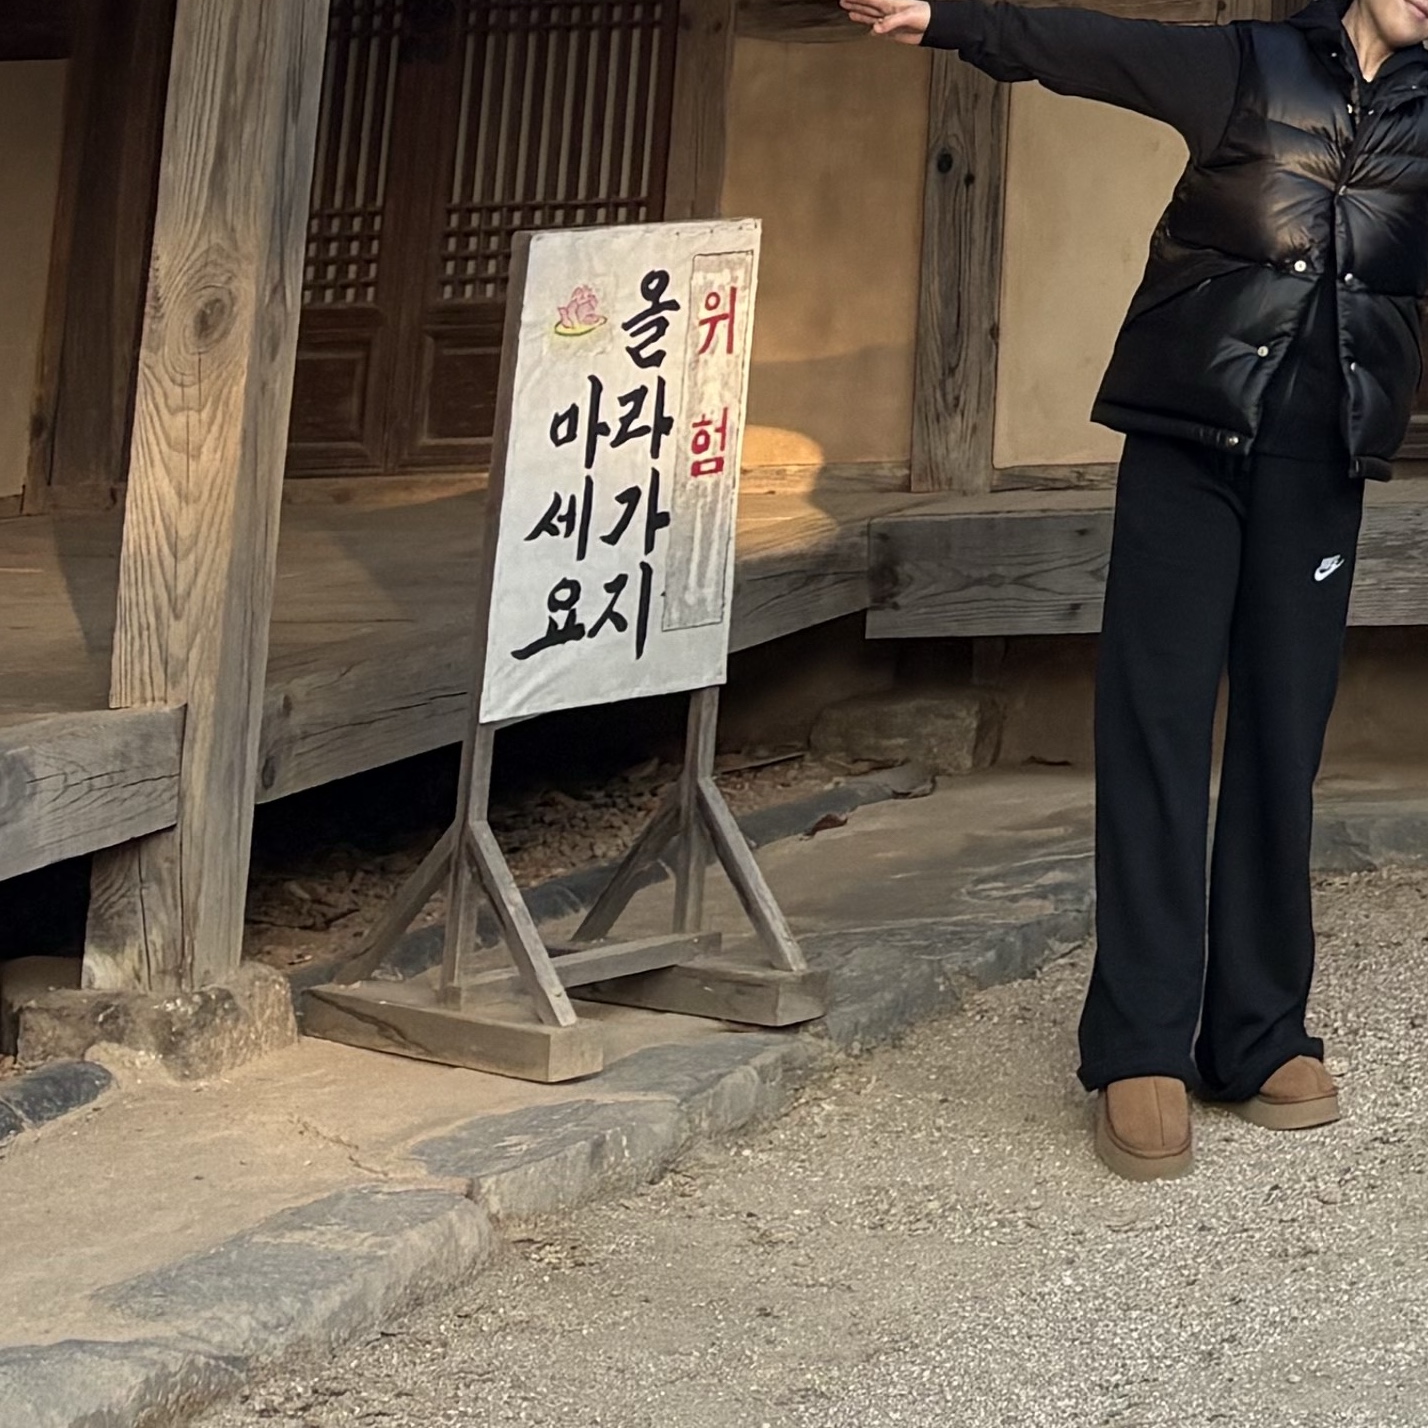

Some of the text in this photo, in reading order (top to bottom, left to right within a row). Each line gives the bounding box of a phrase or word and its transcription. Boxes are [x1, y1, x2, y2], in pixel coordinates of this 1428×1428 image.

[511, 374, 611, 660] 마세요
[587, 270, 682, 660] 올라가지
[690, 286, 737, 478] 위험
